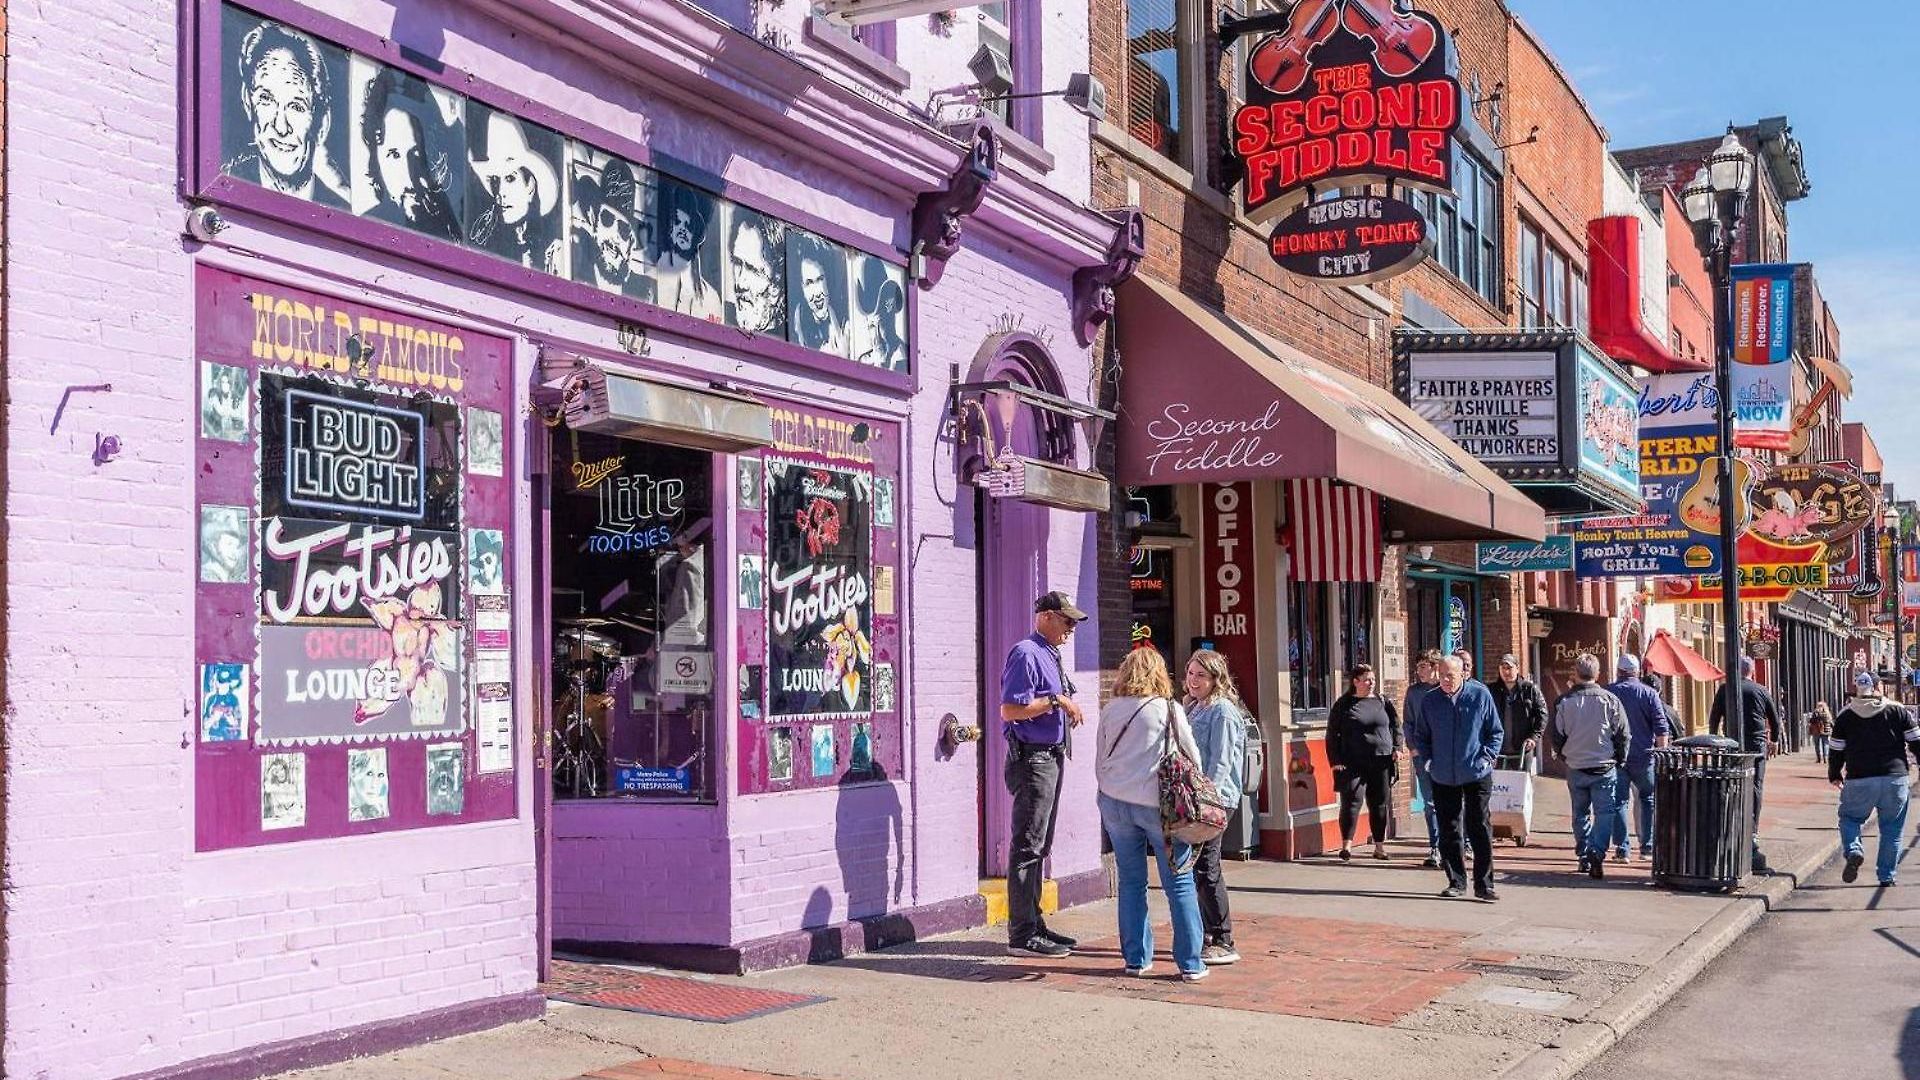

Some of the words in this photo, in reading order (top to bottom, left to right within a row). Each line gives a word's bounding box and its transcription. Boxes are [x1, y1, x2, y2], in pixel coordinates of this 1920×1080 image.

[1313, 63, 1371, 95] THE
[1236, 80, 1456, 156] SECOND
[1247, 130, 1446, 204] FIDDLE
[1308, 199, 1383, 224] MUSIC
[1273, 229, 1348, 256] HONKY
[1356, 221, 1421, 247] TONK
[1318, 251, 1371, 276] CITY
[1755, 283, 1768, 348] Rediscover.
[1772, 286, 1785, 348] Reconnect.
[252, 292, 353, 374] WORLD
[359, 316, 465, 392] FAMOUS
[1420, 380, 1467, 398] FAITH
[1470, 381, 1480, 397] &
[1483, 379, 1554, 397] PRAYERS
[1638, 375, 1719, 417] bert's
[1147, 400, 1281, 440] Second
[1454, 420, 1519, 436] THANKS
[1737, 406, 1783, 421] NOW
[312, 404, 402, 459] BUD
[1480, 438, 1557, 455] WORKERS
[1639, 436, 1717, 457] TERN
[571, 455, 626, 488] Miller
[1146, 436, 1283, 476] Fiddle
[1640, 457, 1698, 477] RLD
[293, 448, 418, 507] LIGHT
[1781, 469, 1810, 481] THE
[596, 474, 684, 535] Lite
[1665, 480, 1684, 504] of
[589, 525, 670, 552] TOOTSIES
[1214, 484, 1241, 613] OFTOP
[1576, 529, 1612, 543] Honky
[1614, 529, 1643, 540] Tonk
[1645, 528, 1689, 540] Heaven
[1582, 543, 1634, 560] Honky
[1638, 542, 1681, 558] Tonk
[264, 515, 452, 623] Tootsies
[1602, 558, 1660, 572] GRILL
[771, 559, 868, 635] Tootsies
[1213, 614, 1247, 636] BAR
[305, 629, 394, 661] ORCHID
[286, 667, 402, 703] LOUNGE
[782, 668, 841, 692] LOUNGE
